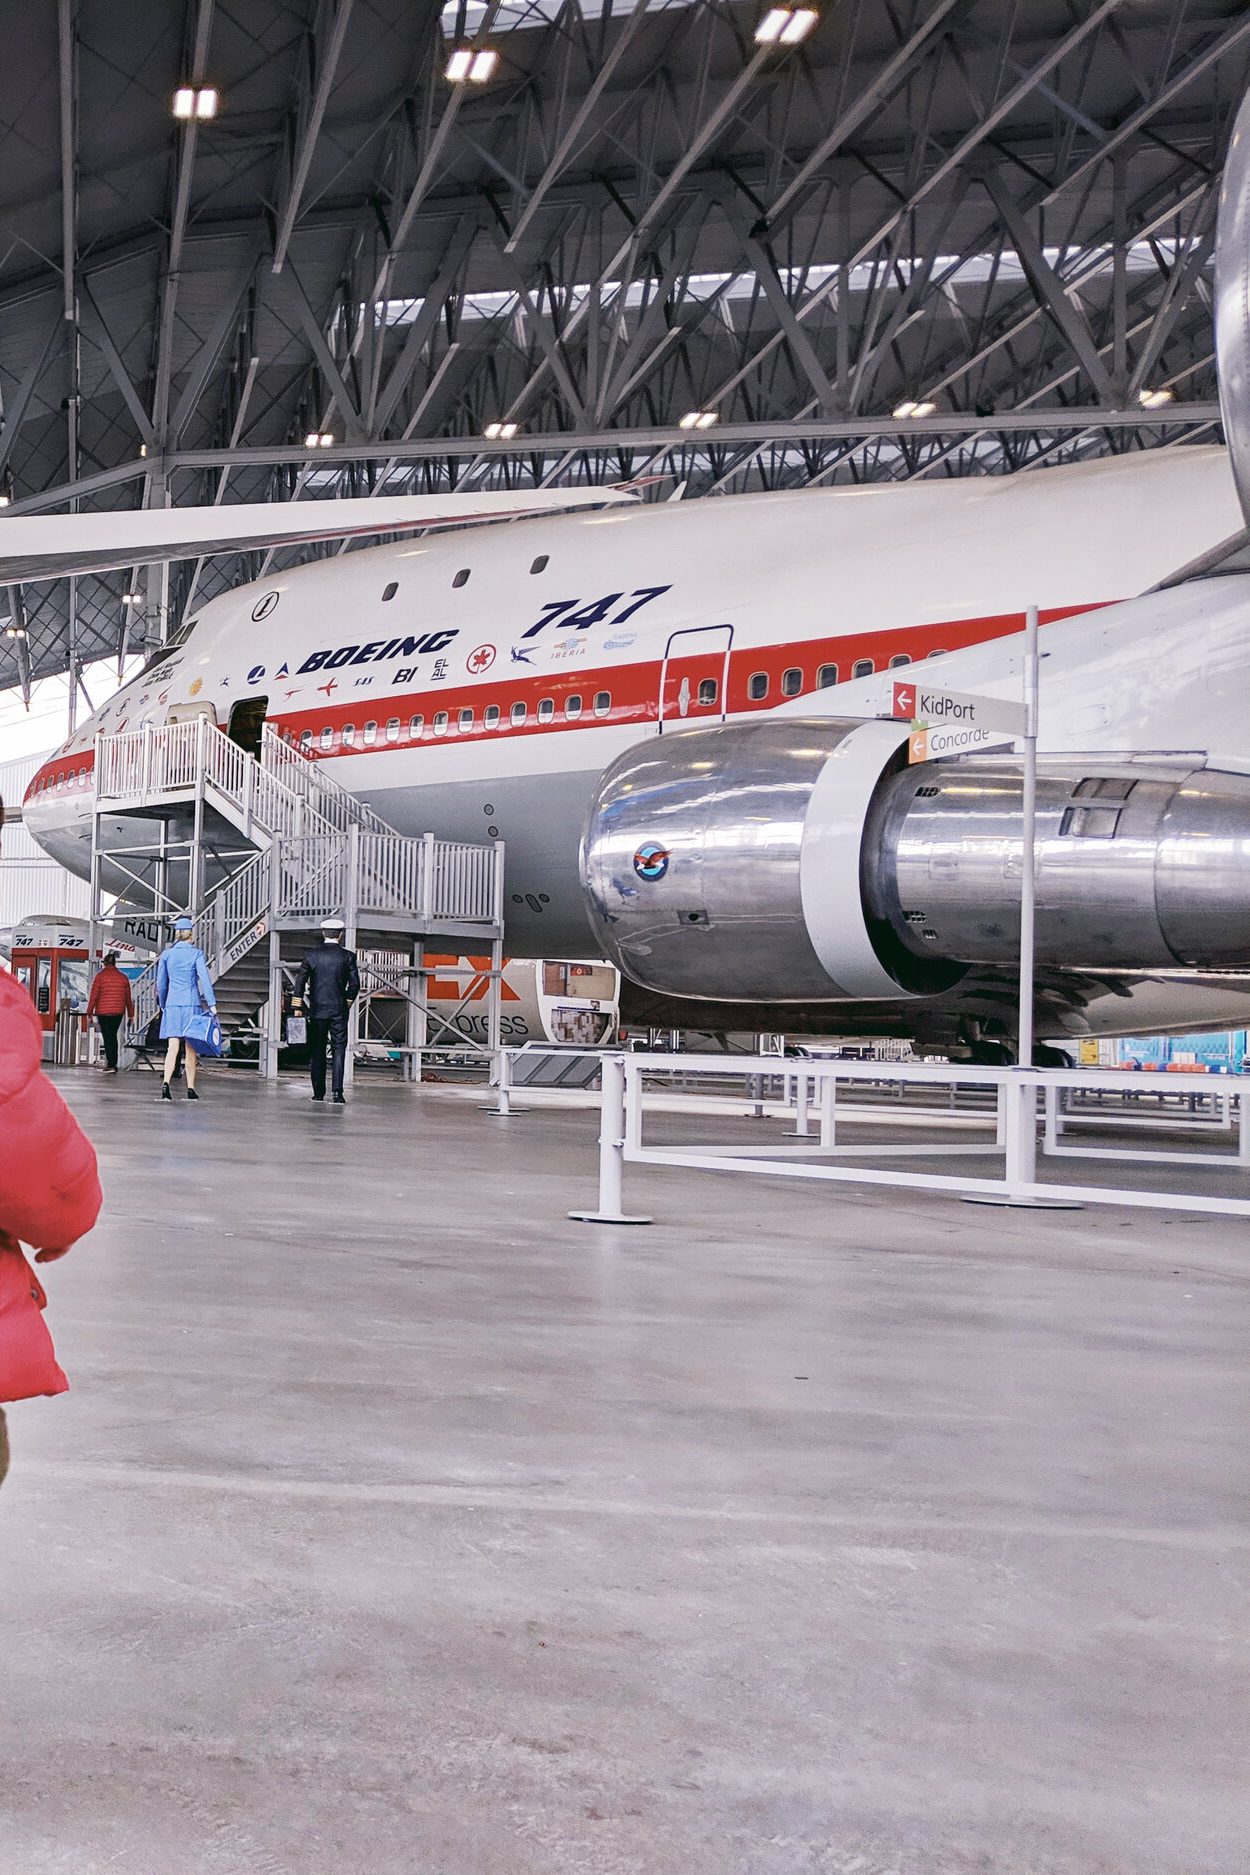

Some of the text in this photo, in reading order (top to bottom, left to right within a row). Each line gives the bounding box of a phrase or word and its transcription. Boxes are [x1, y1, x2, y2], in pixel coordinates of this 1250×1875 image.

[520, 584, 674, 638] 747
[296, 629, 460, 675] BOEING
[551, 648, 586, 659] IBERIA
[434, 658, 449, 668] EL
[431, 668, 447, 678] AL
[920, 694, 975, 720] KidPort
[931, 728, 990, 751] Concorde
[15, 938, 34, 946] 747
[59, 938, 84, 947] 747
[230, 931, 257, 961] ENTER
